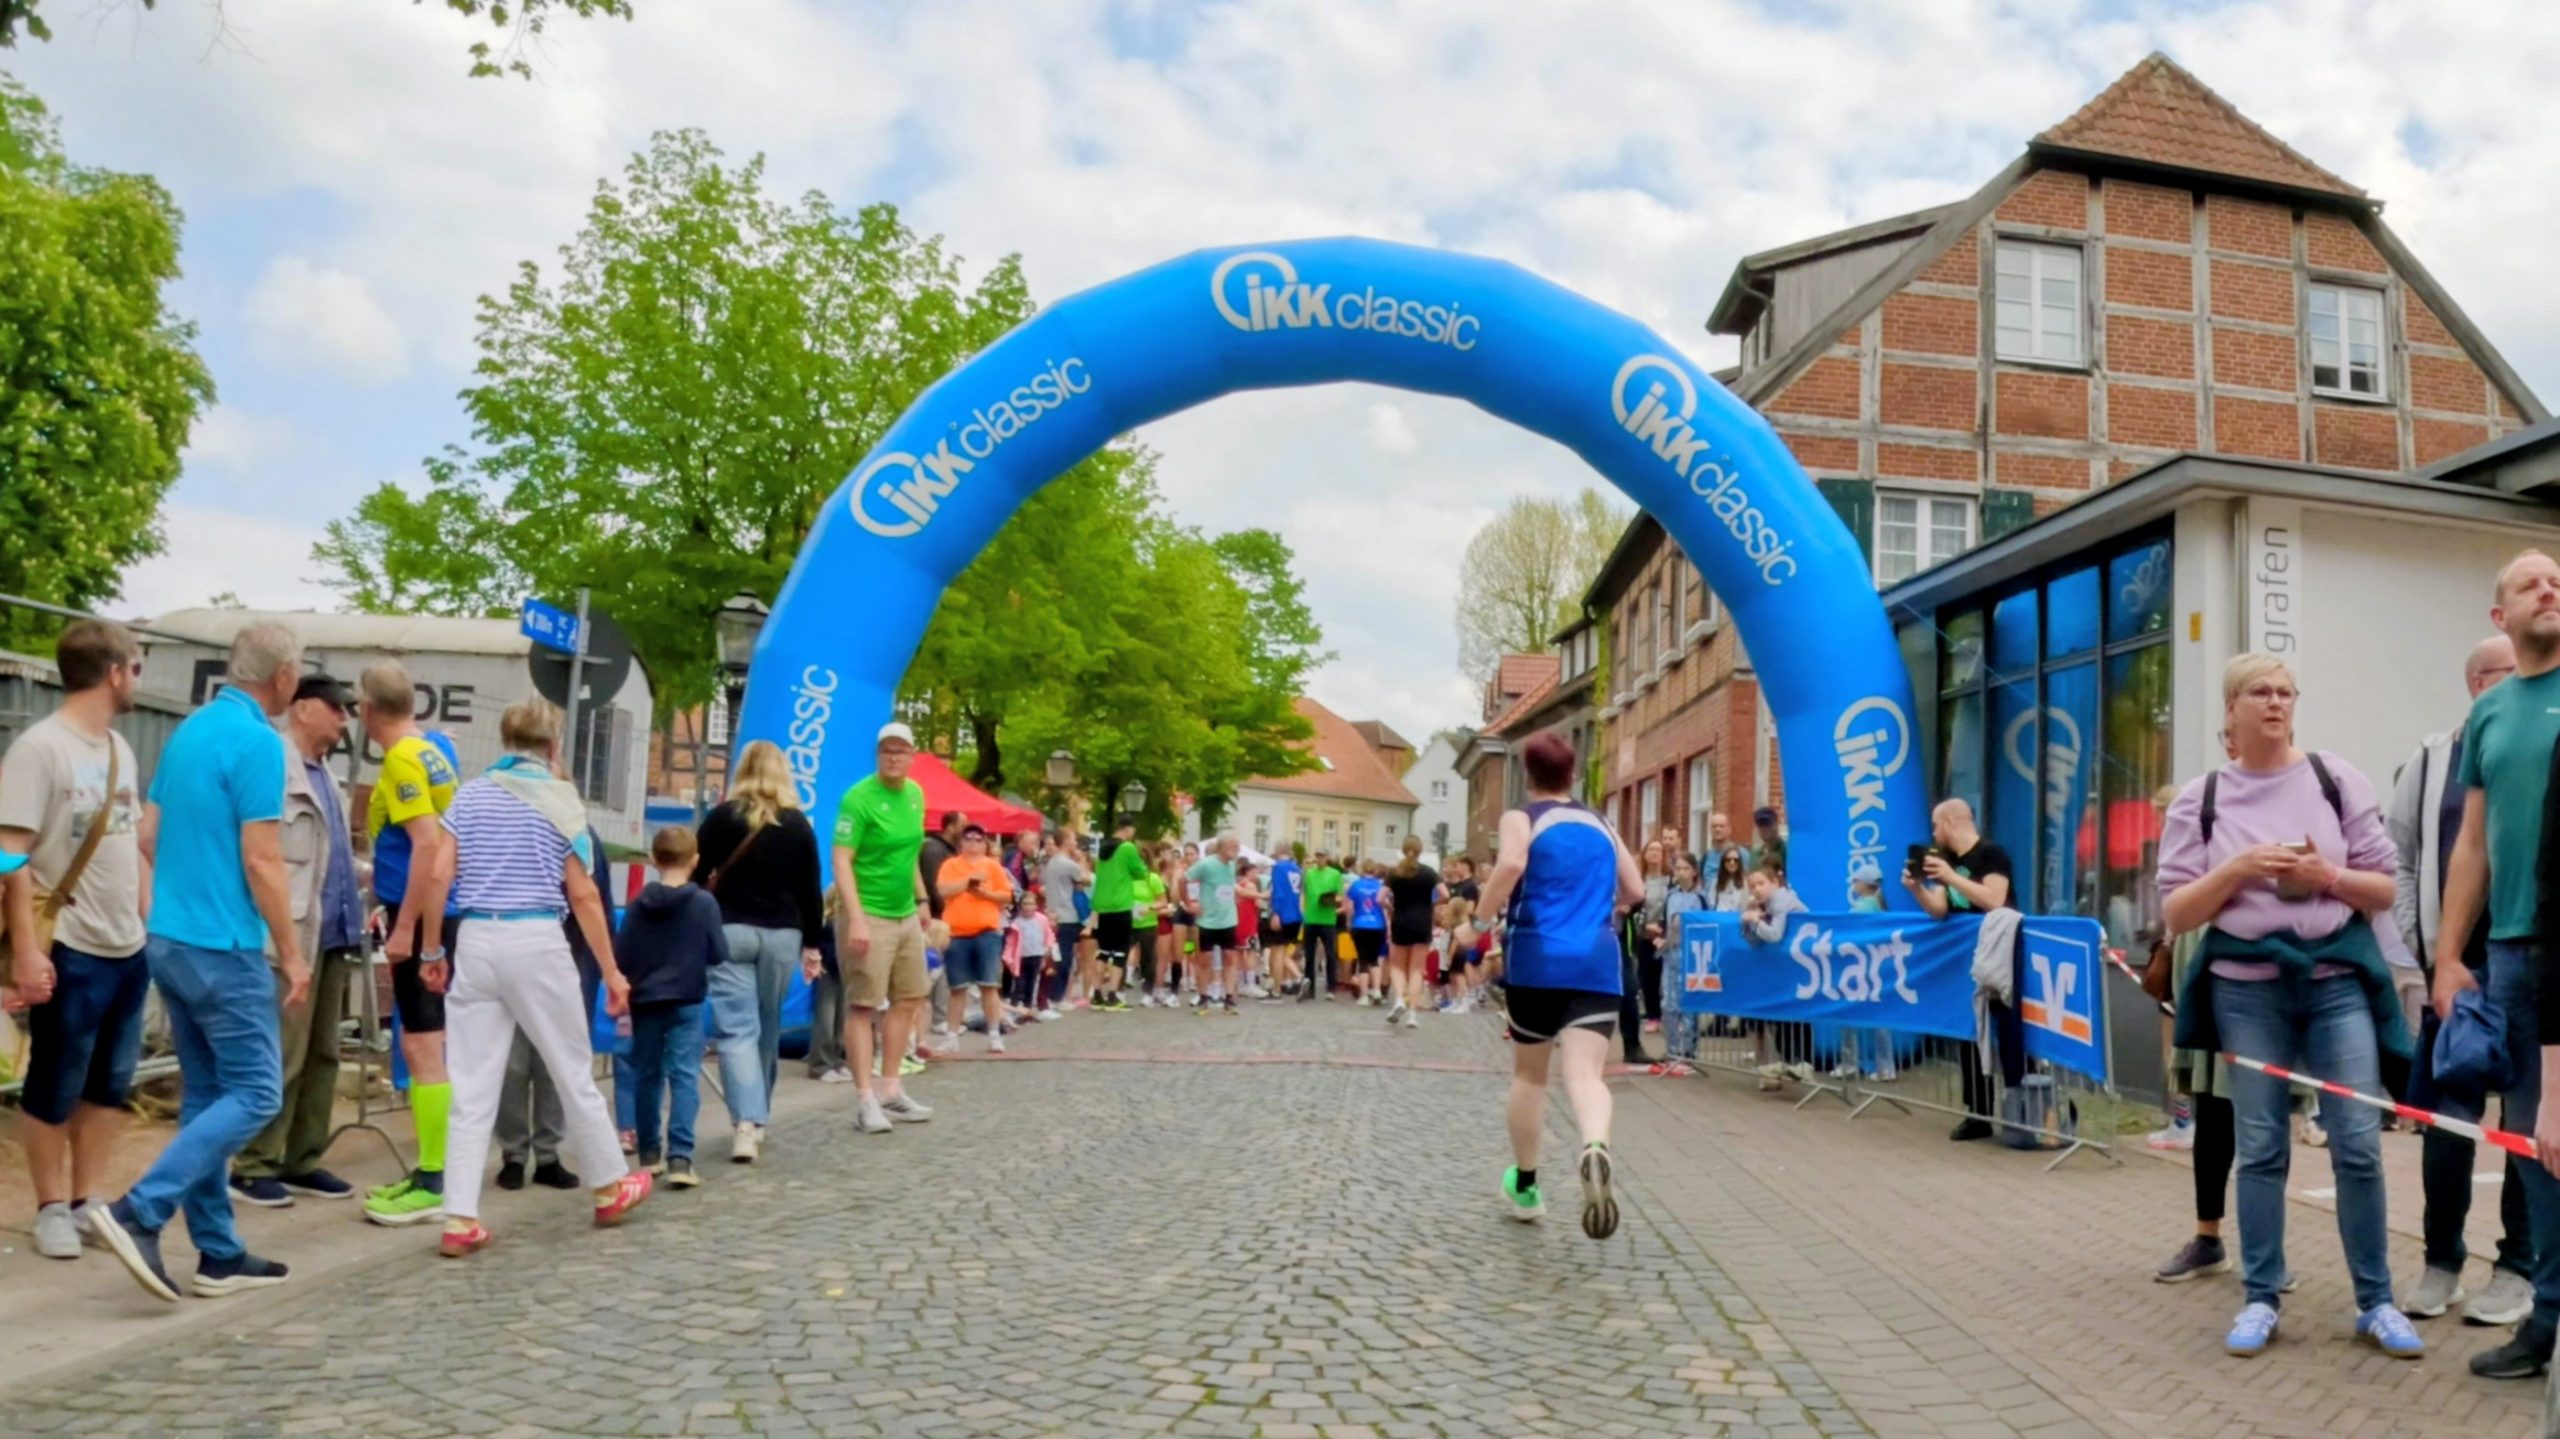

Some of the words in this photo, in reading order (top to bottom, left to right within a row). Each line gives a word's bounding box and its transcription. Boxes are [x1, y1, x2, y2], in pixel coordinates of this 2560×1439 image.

[1336, 285, 1480, 351] classic
[959, 357, 1092, 459] classic
[1690, 462, 1798, 586] classic
[2257, 526, 2296, 653] grafen
[784, 664, 839, 812] classic
[1790, 922, 1919, 1004] Start
